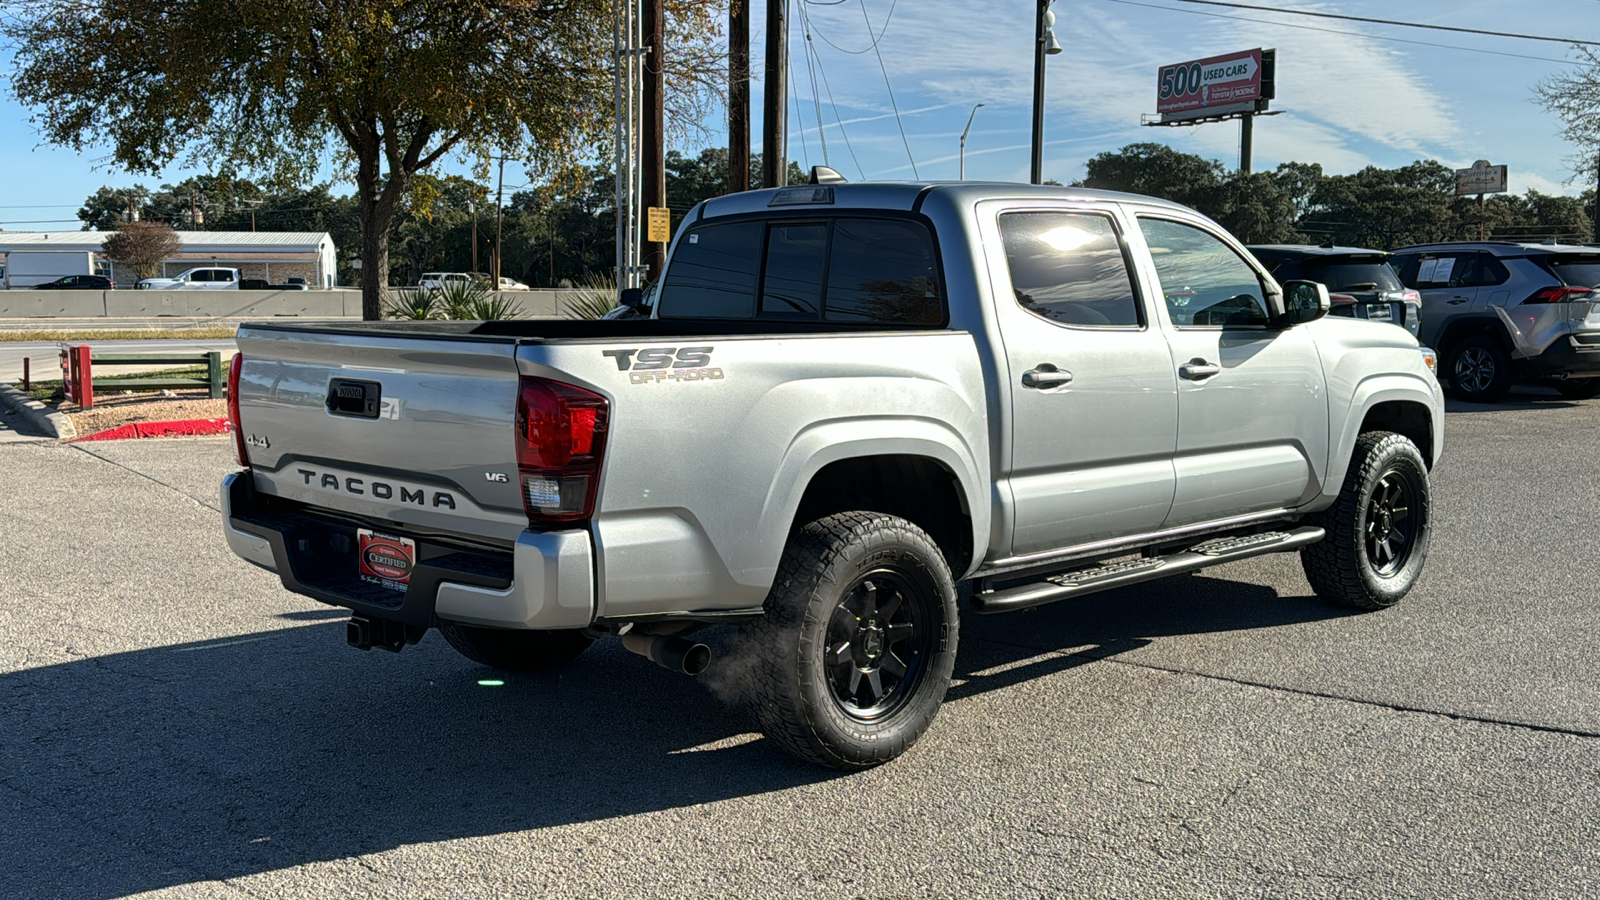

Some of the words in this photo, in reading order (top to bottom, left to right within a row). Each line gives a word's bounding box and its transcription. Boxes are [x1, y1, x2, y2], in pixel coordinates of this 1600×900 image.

[1159, 62, 1202, 99] 500
[1203, 69, 1225, 81] USED
[1225, 63, 1248, 77] CARS
[1211, 91, 1230, 99] TOYOTA
[602, 346, 714, 371] TSS
[629, 367, 725, 384] OFF-ROAD
[340, 387, 362, 398] TOYOTA
[485, 471, 510, 483] V6
[297, 468, 456, 510] TACOMA
